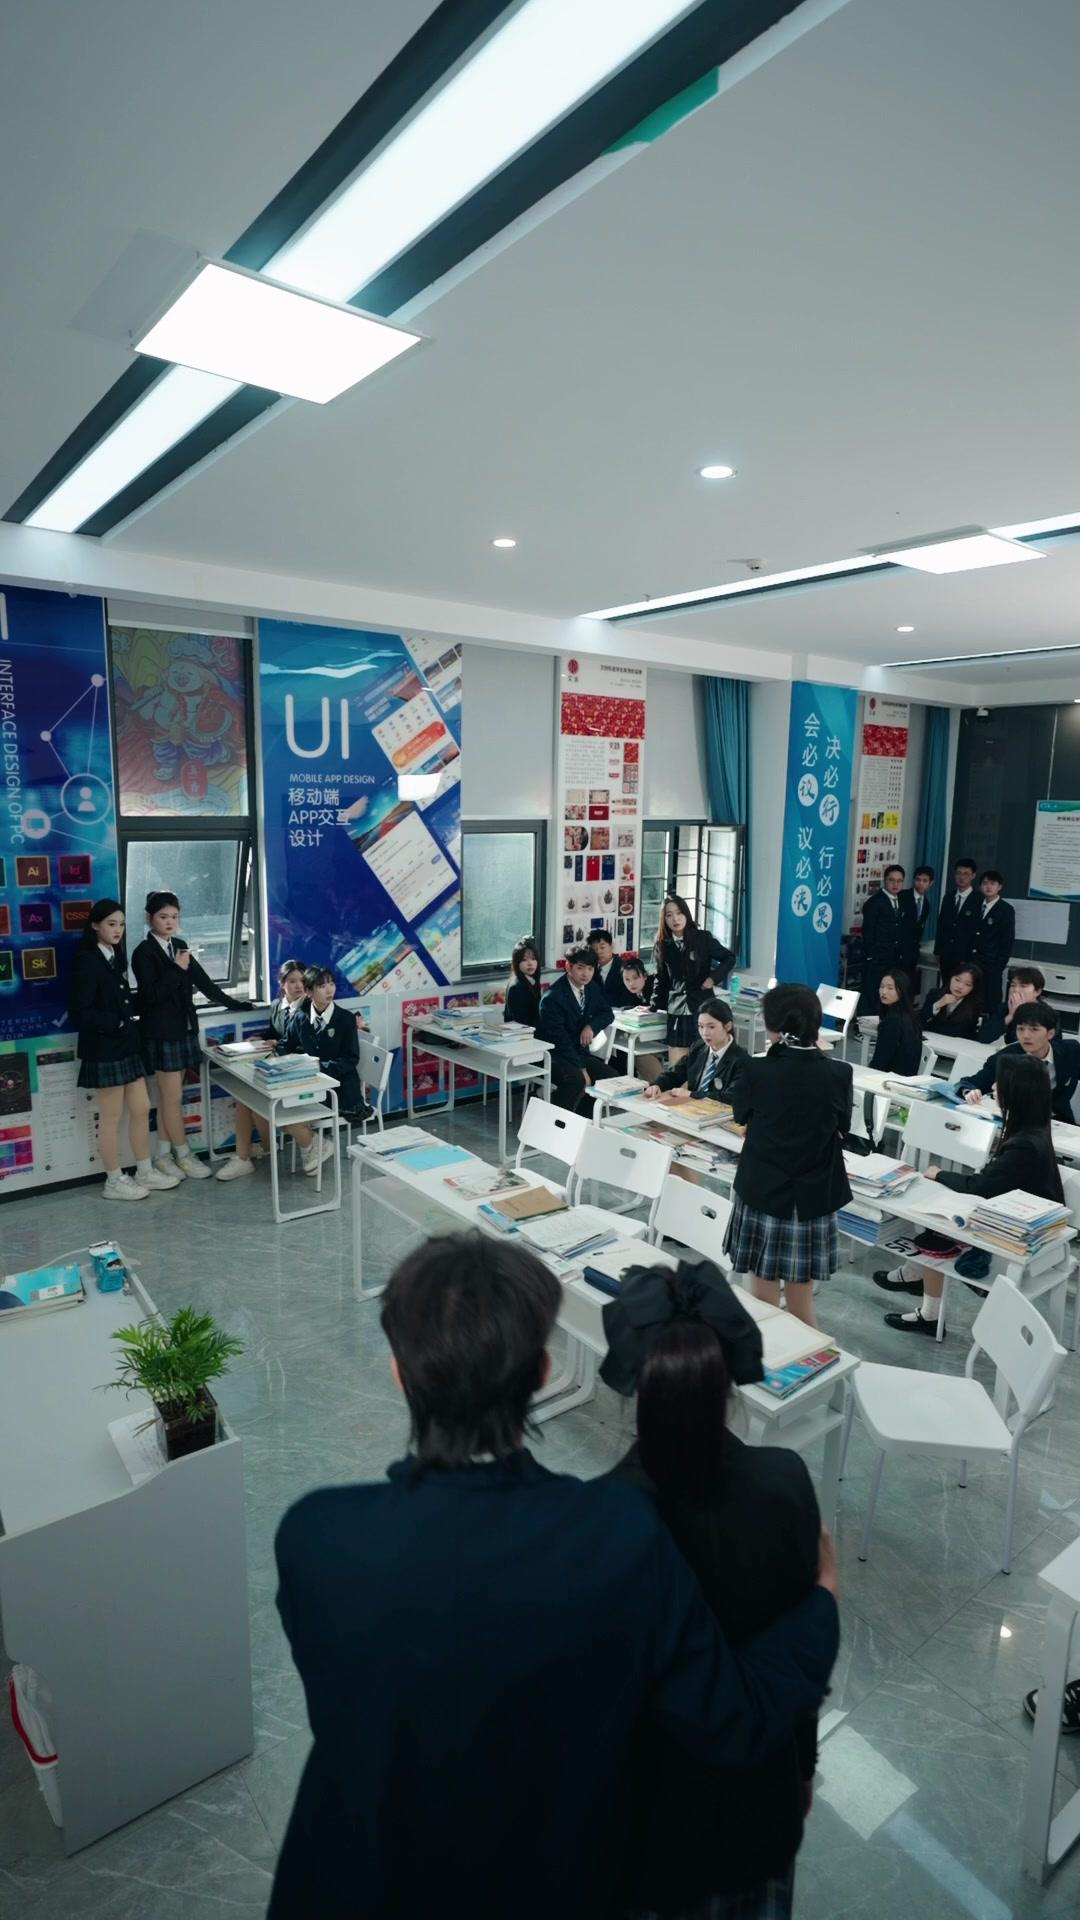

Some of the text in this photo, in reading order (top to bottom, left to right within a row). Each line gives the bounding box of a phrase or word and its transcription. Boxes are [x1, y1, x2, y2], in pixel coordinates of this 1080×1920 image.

[285, 693, 350, 760] UI
[0, 659, 25, 845] INTERFACE DESIGN OF PC
[800, 712, 820, 801] 会必议
[289, 773, 375, 784] MOBILE APP DESIGN
[822, 735, 842, 822] 决必行
[288, 788, 340, 806] 移动端
[288, 808, 352, 826] APP交互
[289, 828, 324, 847] 设计
[27, 866, 40, 877] Ai
[32, 959, 48, 970] Sk
